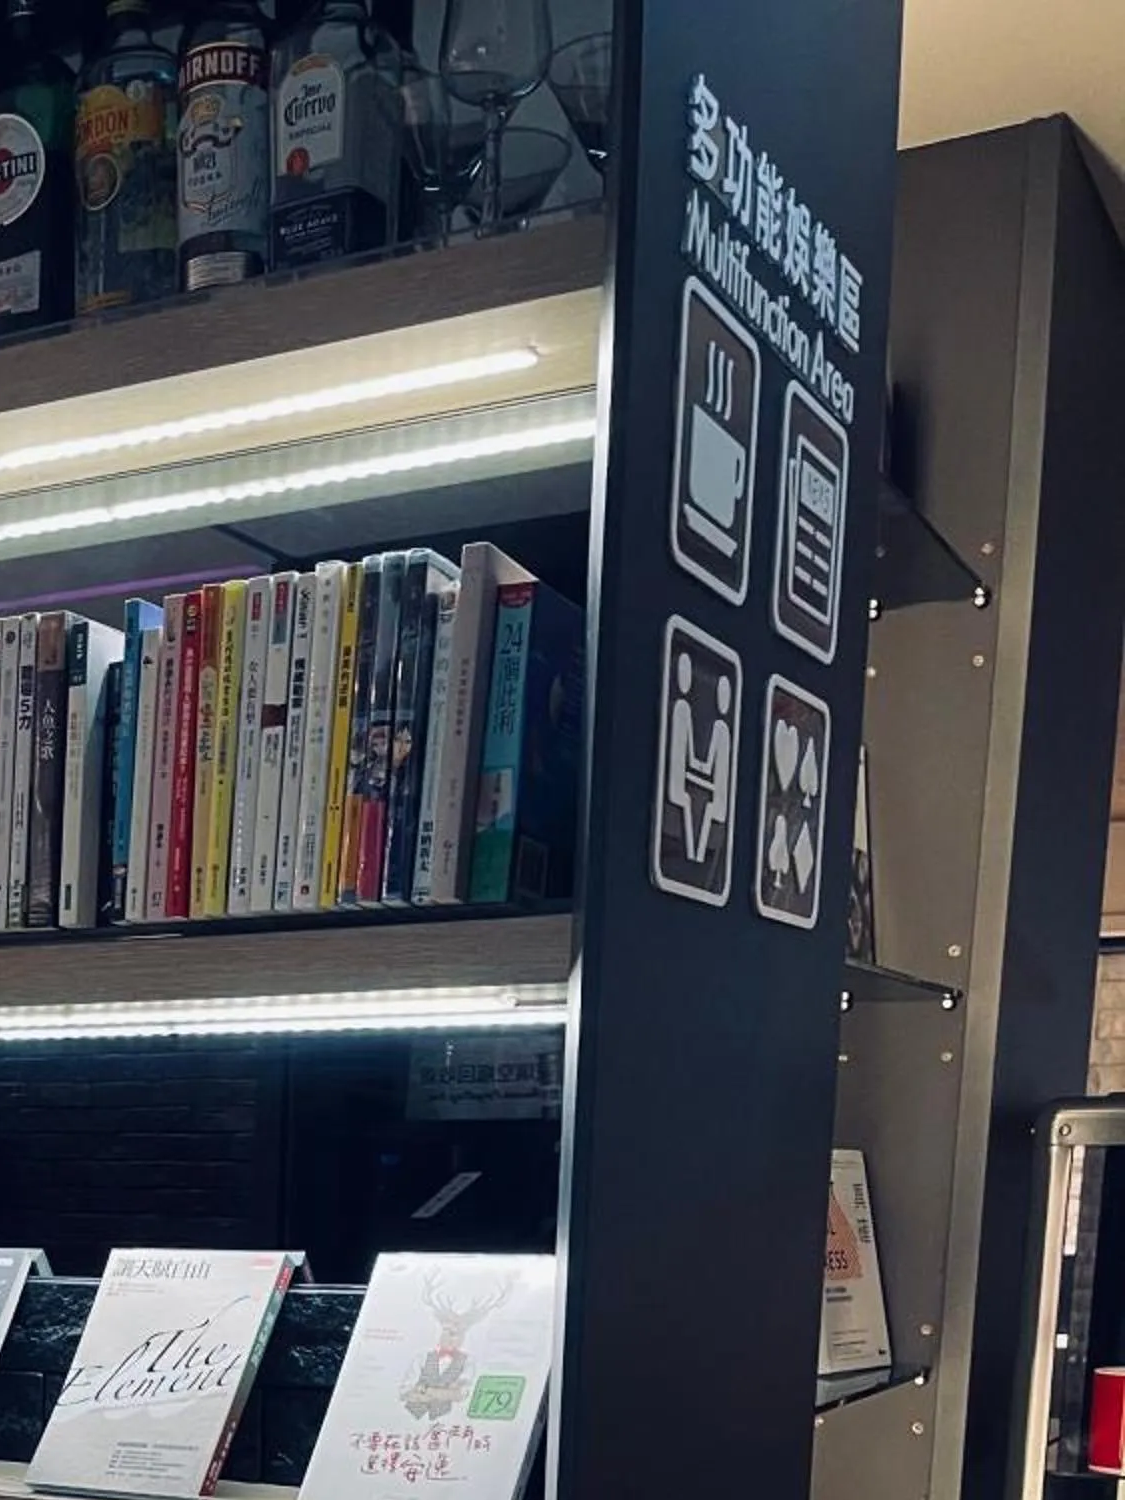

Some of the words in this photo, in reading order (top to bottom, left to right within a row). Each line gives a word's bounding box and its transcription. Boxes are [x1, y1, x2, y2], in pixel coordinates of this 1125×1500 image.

[682, 188, 810, 375] Multifunction
[811, 330, 855, 425] Area
[56, 1341, 242, 1407] Element
[146, 1318, 228, 1374] The
[482, 1389, 515, 1414] 79
